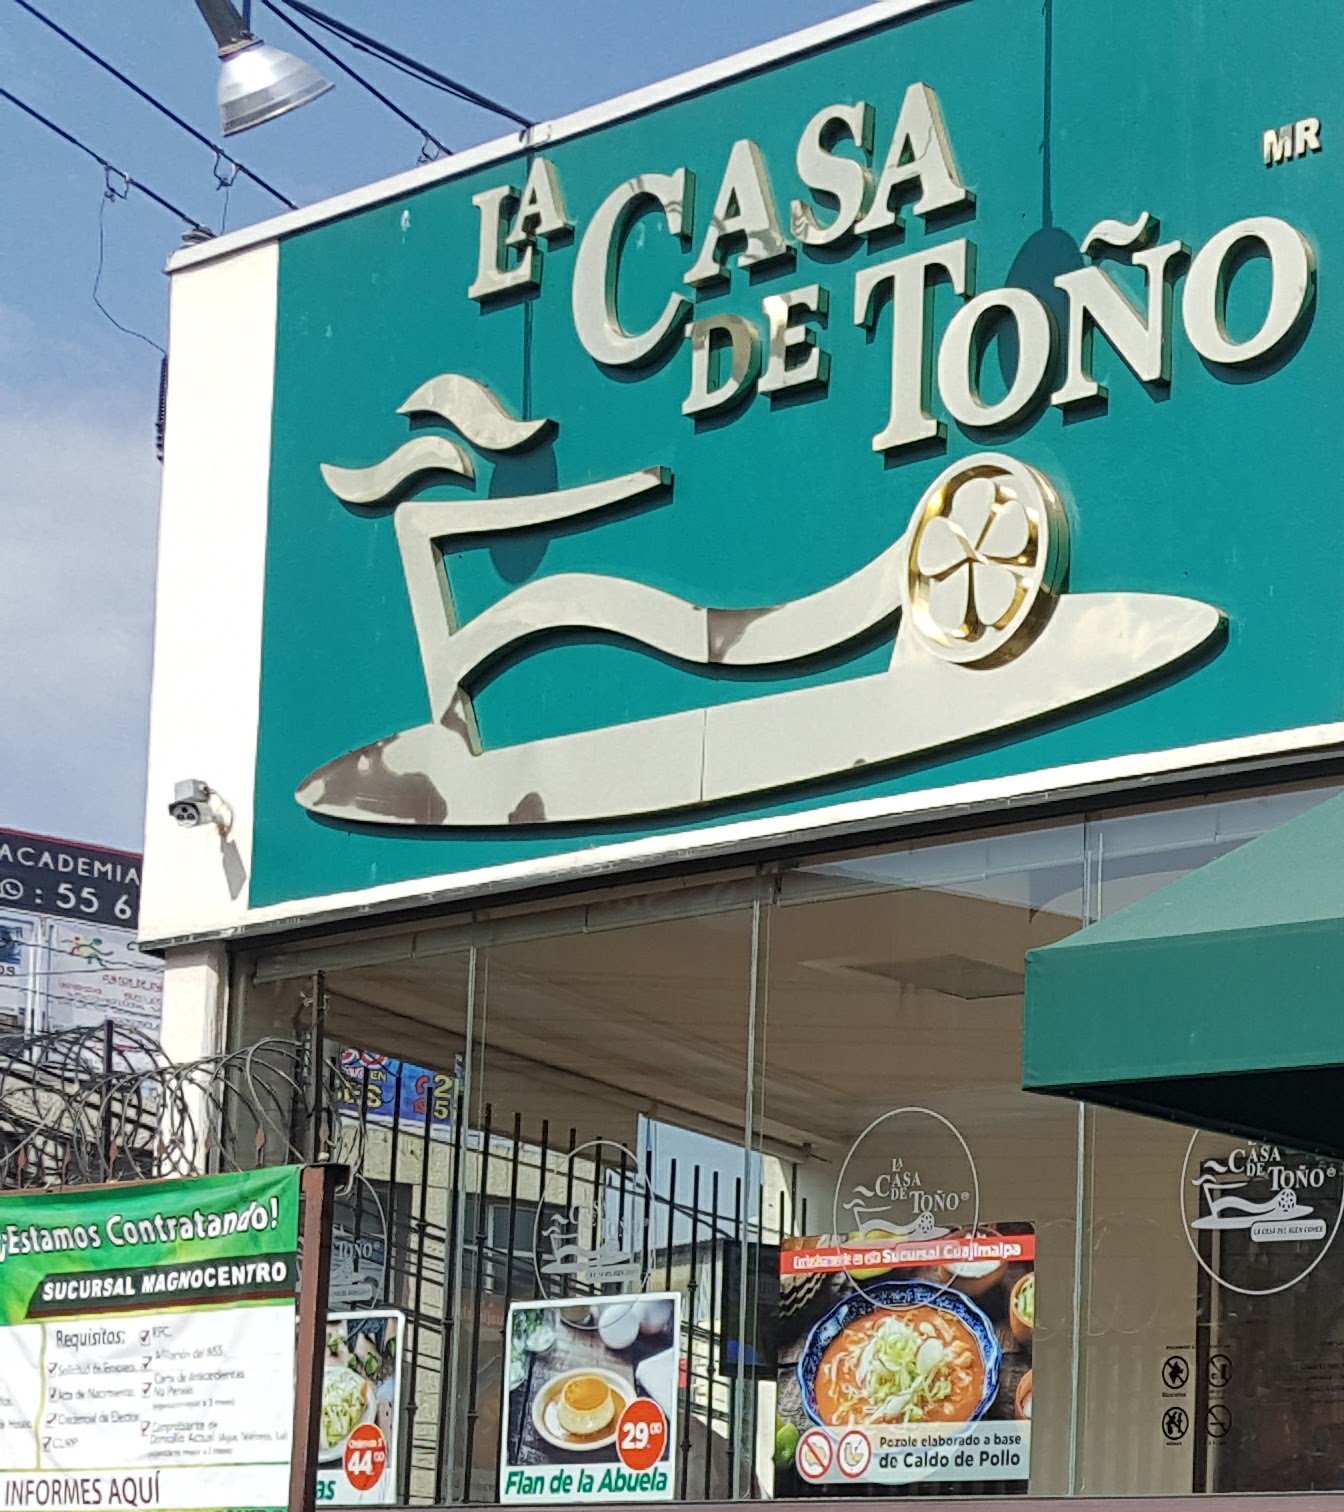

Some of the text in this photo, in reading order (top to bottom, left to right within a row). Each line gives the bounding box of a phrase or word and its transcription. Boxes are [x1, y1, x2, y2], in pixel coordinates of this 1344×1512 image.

[1263, 117, 1322, 168] MR
[468, 155, 573, 304] LA
[571, 80, 976, 368] CASA
[682, 209, 1316, 455] DE TOÑO
[0, 843, 140, 886] ACADEMIA
[56, 882, 99, 914] 55
[1228, 1145, 1281, 1174] CASA
[875, 1172, 921, 1199] CASA
[1247, 1162, 1325, 1191] DE TOÑO
[891, 1187, 959, 1213] DE TOÑO
[0, 1197, 280, 1262] ¡Estamos Contratando!
[882, 1244, 939, 1263] Sucursal
[943, 1242, 1021, 1262] Cuajimalpa
[42, 1261, 287, 1301] SUCURSAL MAGNOCENTRO
[56, 1328, 126, 1352] Requisitos:
[921, 1434, 980, 1447] elaborado
[983, 1435, 991, 1445] a
[993, 1433, 1022, 1445] base
[879, 1449, 1020, 1468] de Caldo de Pollo
[4, 1470, 160, 1507] INFORMES AQUÍ
[504, 1464, 668, 1495] Flan de la Abuela
